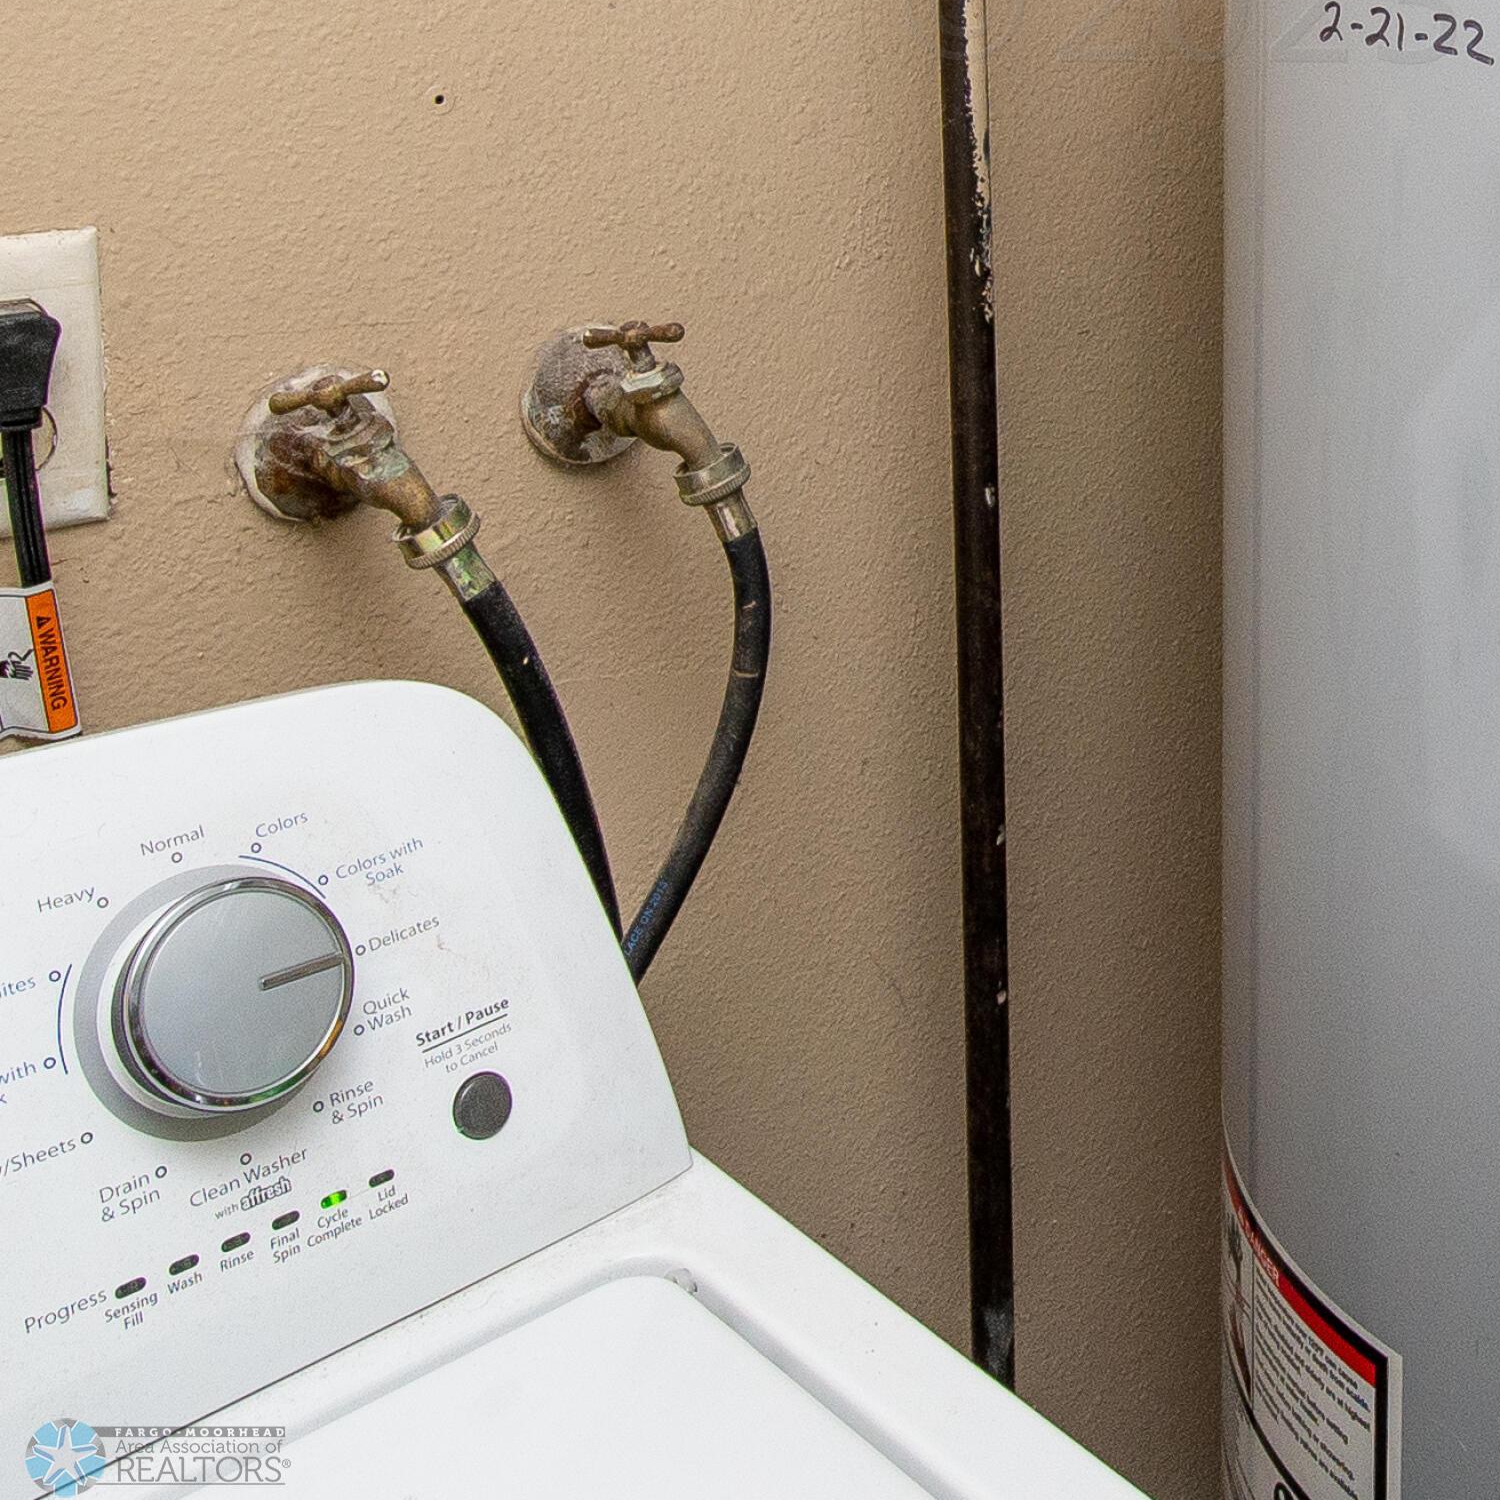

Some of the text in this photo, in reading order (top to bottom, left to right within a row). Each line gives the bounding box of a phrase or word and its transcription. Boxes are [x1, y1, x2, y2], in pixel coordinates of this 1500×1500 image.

[1319, 1, 1494, 66] 2-21-22
[35, 628, 68, 711] WARNING
[140, 824, 205, 855] Normal
[255, 812, 308, 838] Colors
[335, 837, 424, 879] Colors with
[366, 863, 404, 886] Soak
[37, 887, 95, 913] Heavy
[368, 916, 440, 951] Delicates
[0, 976, 36, 1000] ites
[362, 987, 410, 1015] Quick
[367, 1005, 412, 1031] Wash
[415, 1021, 455, 1047] Start
[465, 999, 509, 1025] Pause
[424, 1022, 512, 1068] Hold 3 Seconds
[445, 1042, 498, 1073] to Cancel
[329, 1080, 374, 1107] Rinse
[331, 1094, 384, 1125] & Spin
[0, 1138, 76, 1177] /Sheets
[99, 1173, 150, 1204] Drain
[189, 1148, 308, 1207] Clean Washer
[100, 1189, 161, 1222] & Spin
[214, 1175, 292, 1220] with affresh
[368, 1194, 409, 1221] Locked
[377, 1185, 396, 1202] Lid
[306, 1215, 363, 1248] Complete
[317, 1207, 349, 1230] Cycle
[270, 1228, 300, 1250] Final
[273, 1244, 301, 1264] Spin
[219, 1249, 255, 1273] Rinse
[167, 1271, 203, 1295] Wash
[24, 1289, 108, 1334] Progress
[104, 1291, 158, 1324] Sensing
[123, 1310, 144, 1330] Fill
